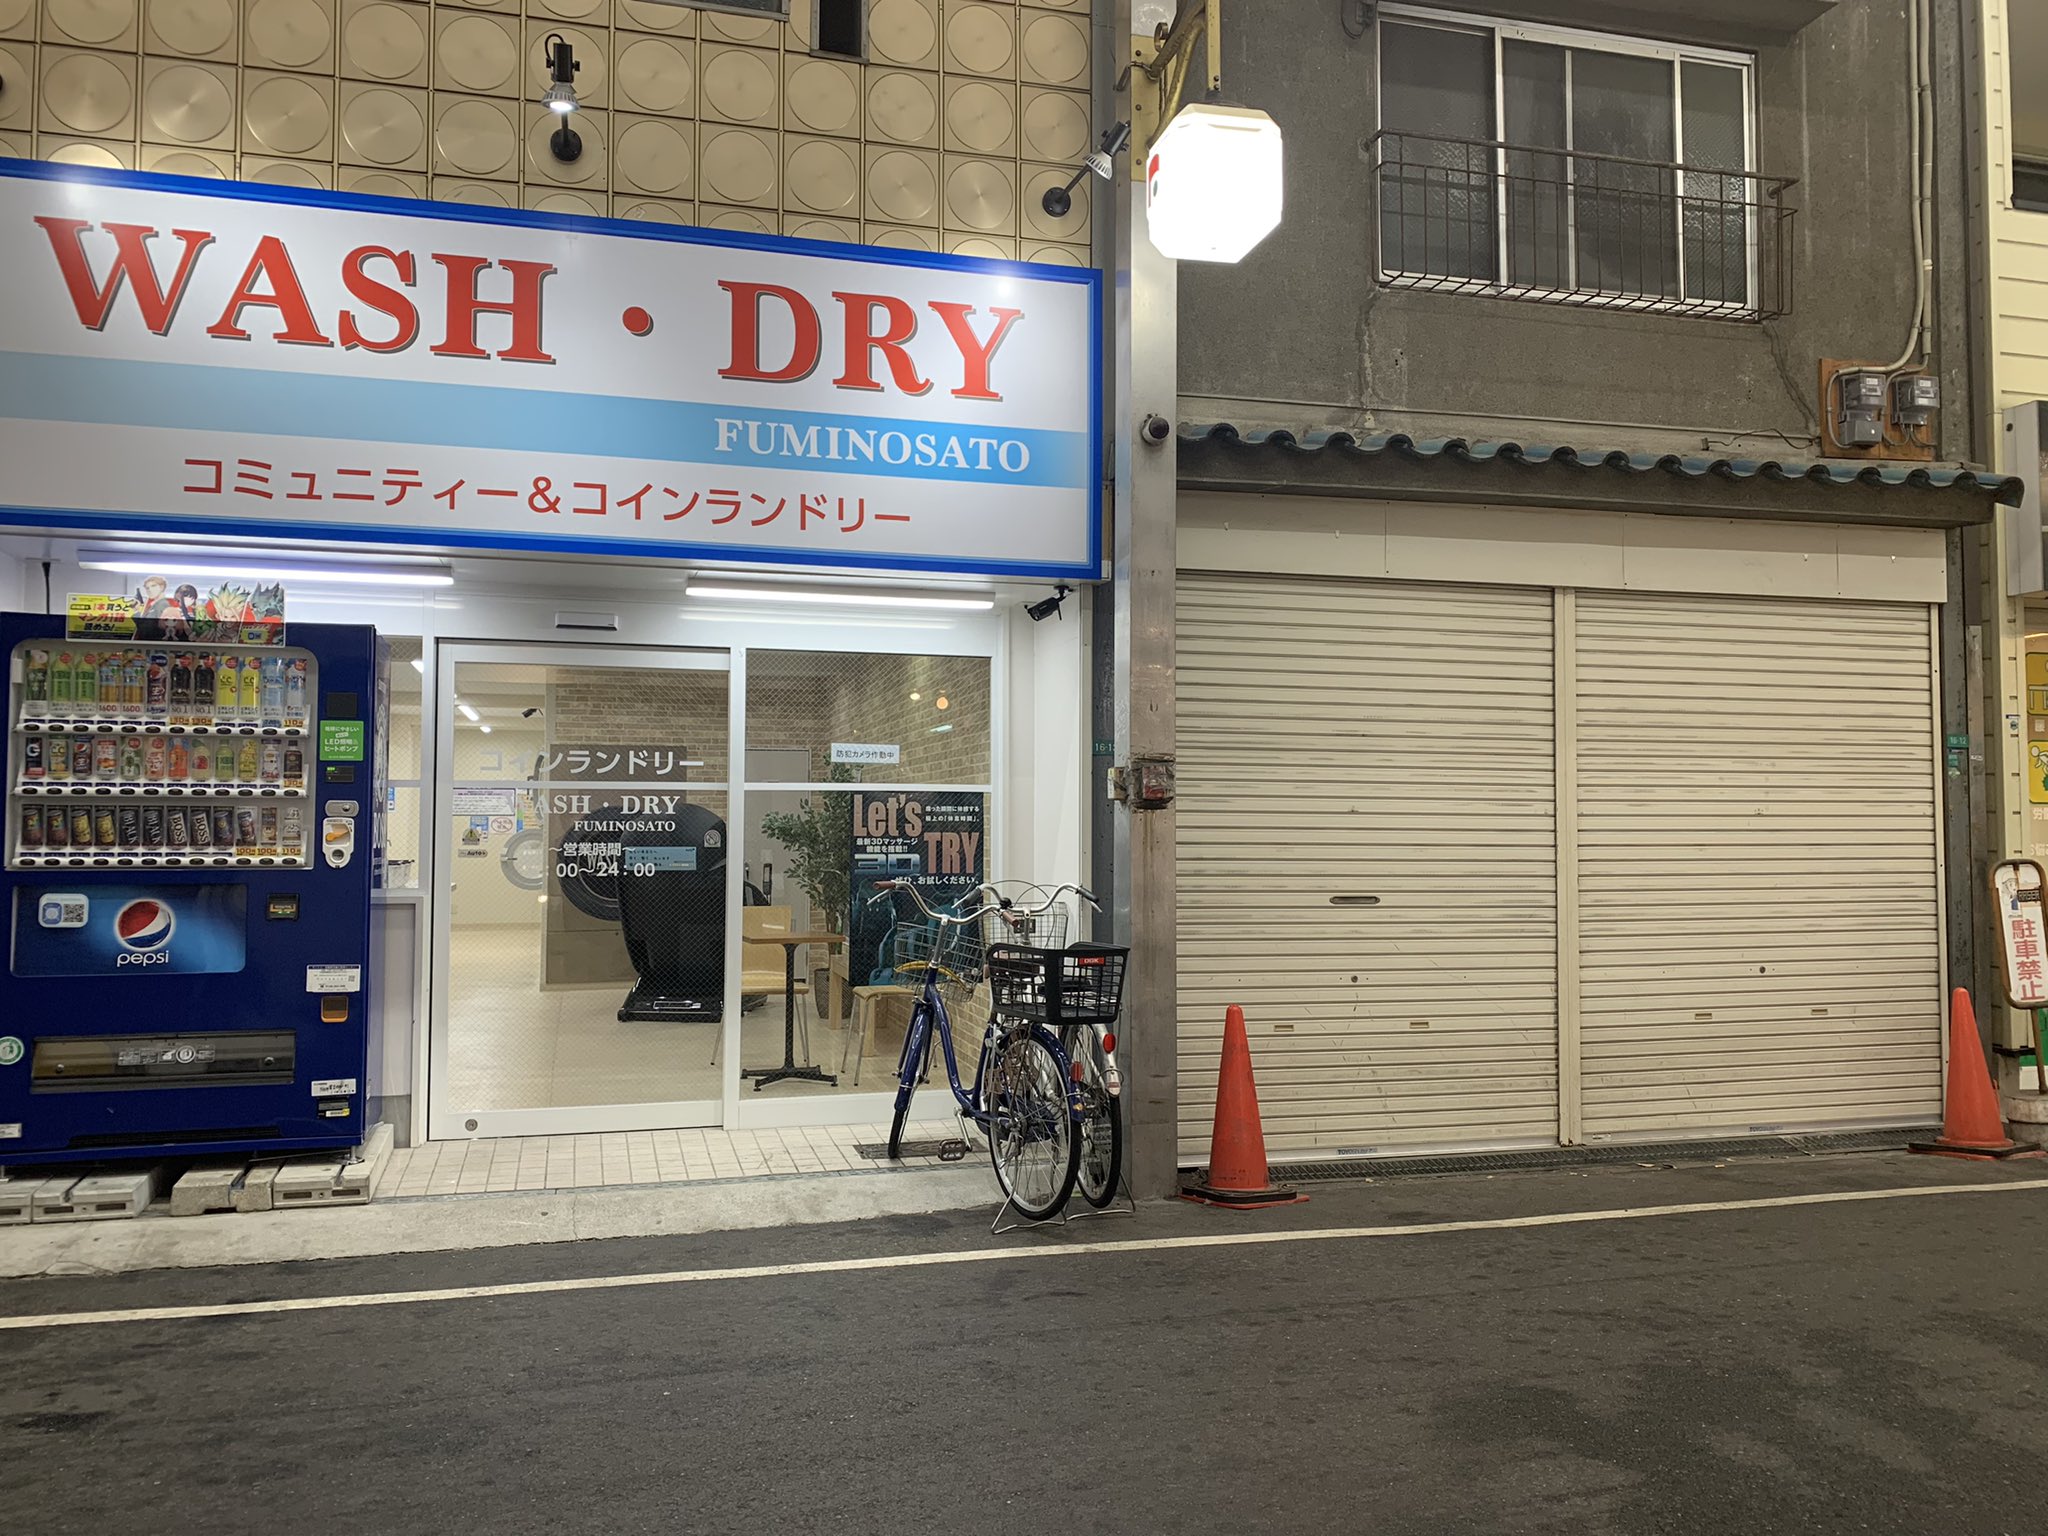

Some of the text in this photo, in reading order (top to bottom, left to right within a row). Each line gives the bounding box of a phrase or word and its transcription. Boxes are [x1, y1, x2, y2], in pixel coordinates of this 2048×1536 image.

[34, 216, 557, 364] WASH
[718, 280, 1024, 402] DRY
[714, 417, 1031, 474] FUMINOSATO
[183, 458, 911, 533] コミュニティー&コインランドリー
[479, 750, 704, 775] コインランドリー
[620, 795, 680, 814] DRY
[574, 820, 676, 832] FUMINOSATO
[924, 832, 979, 874] TRY
[117, 950, 169, 968] pepsi
[2011, 918, 2046, 1001] 駐車禁止
